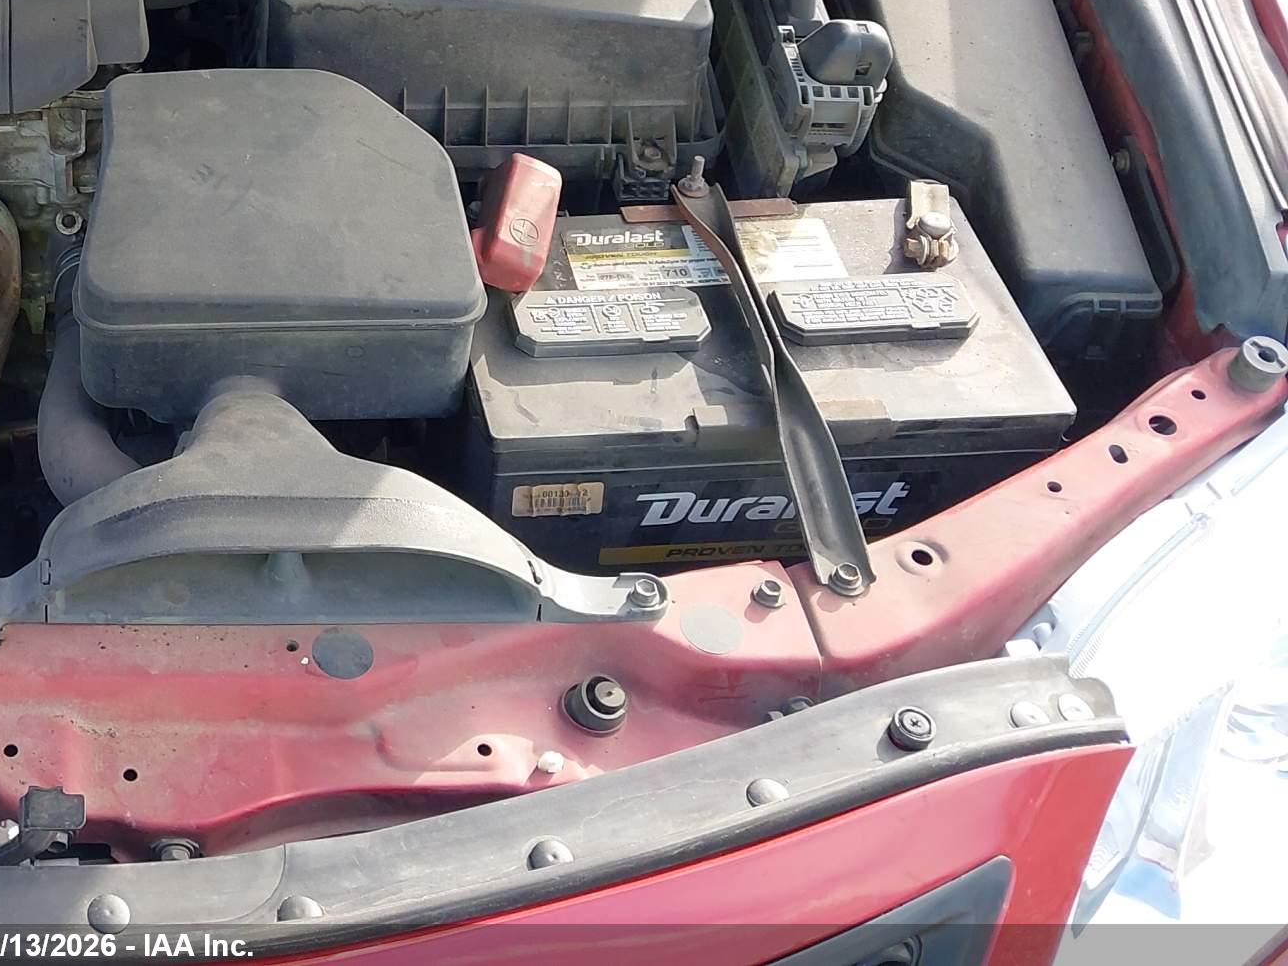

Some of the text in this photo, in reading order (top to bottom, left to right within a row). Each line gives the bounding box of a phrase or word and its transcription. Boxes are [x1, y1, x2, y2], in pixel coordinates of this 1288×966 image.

[570, 229, 665, 247] Duralast
[663, 267, 688, 278] 710
[557, 294, 606, 305] DANGER
[616, 292, 662, 303] POISON
[636, 481, 909, 526] Durast
[666, 545, 765, 558] PROVEN
